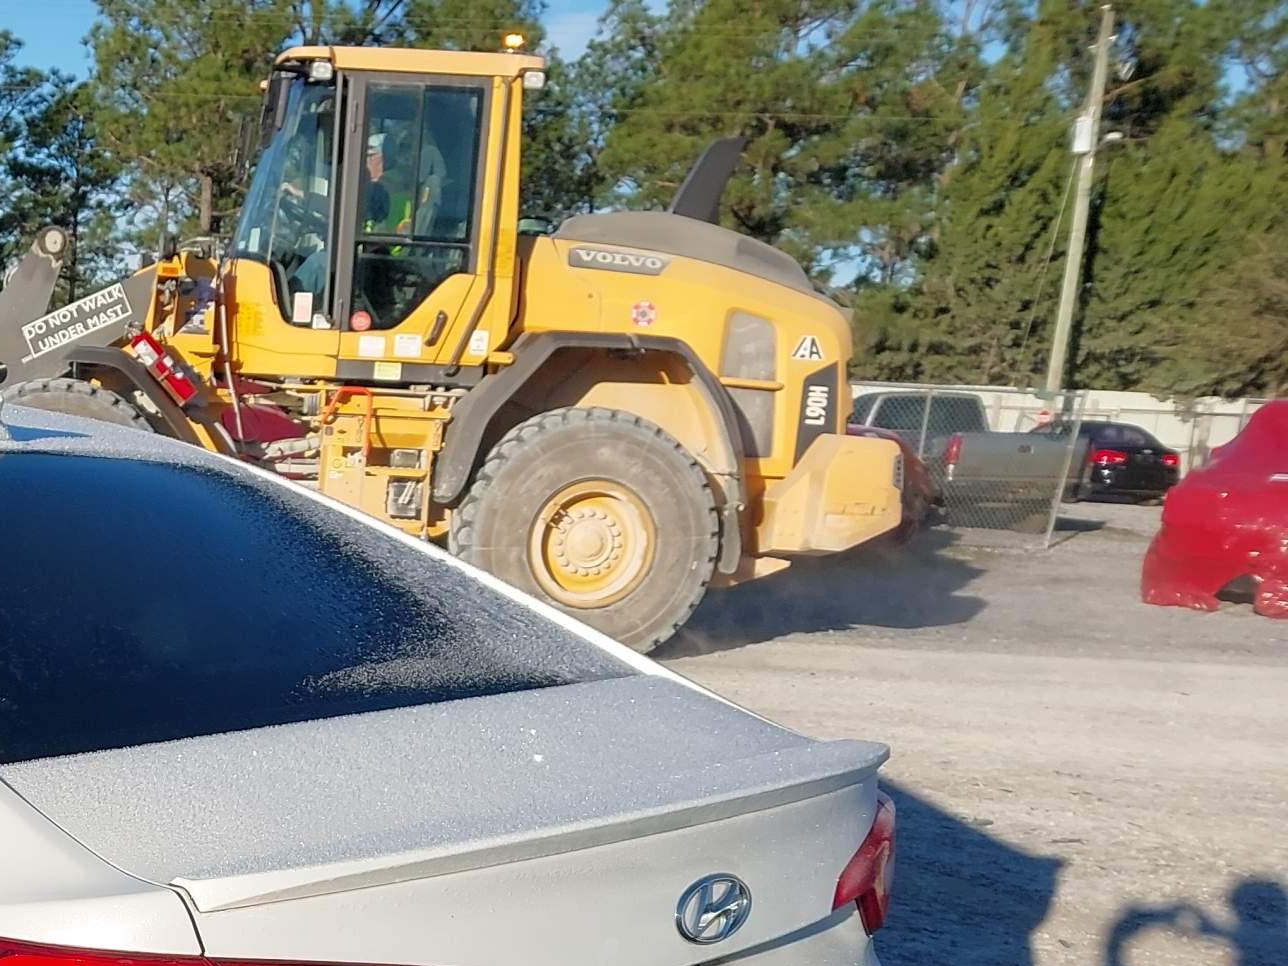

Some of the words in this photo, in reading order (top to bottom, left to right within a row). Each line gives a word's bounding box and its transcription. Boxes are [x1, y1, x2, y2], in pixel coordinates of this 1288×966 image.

[575, 249, 663, 269] VOLVO
[24, 321, 47, 339] DO
[48, 304, 79, 328] NOT
[81, 287, 124, 313] WALK
[38, 322, 86, 351] UNDER
[86, 304, 123, 329] MAST
[804, 385, 829, 426] L90H
